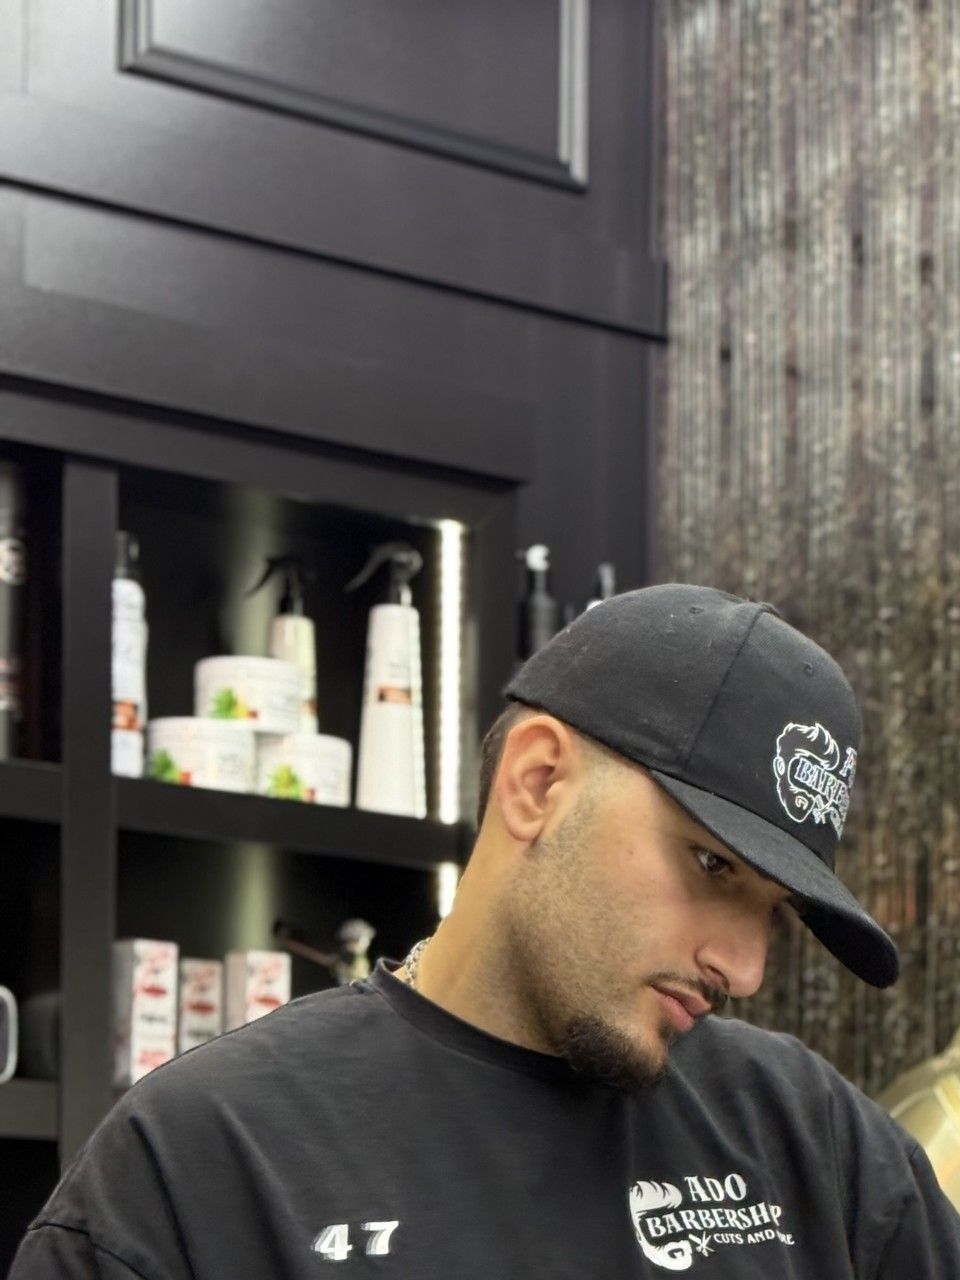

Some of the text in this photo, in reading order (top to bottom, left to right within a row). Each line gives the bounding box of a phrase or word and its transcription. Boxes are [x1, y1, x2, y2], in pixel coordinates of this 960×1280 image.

[684, 1173, 747, 1203] ADO
[645, 1202, 783, 1239] BARBERSHP
[713, 1232, 745, 1245] CUTS
[747, 1228, 776, 1244] AND
